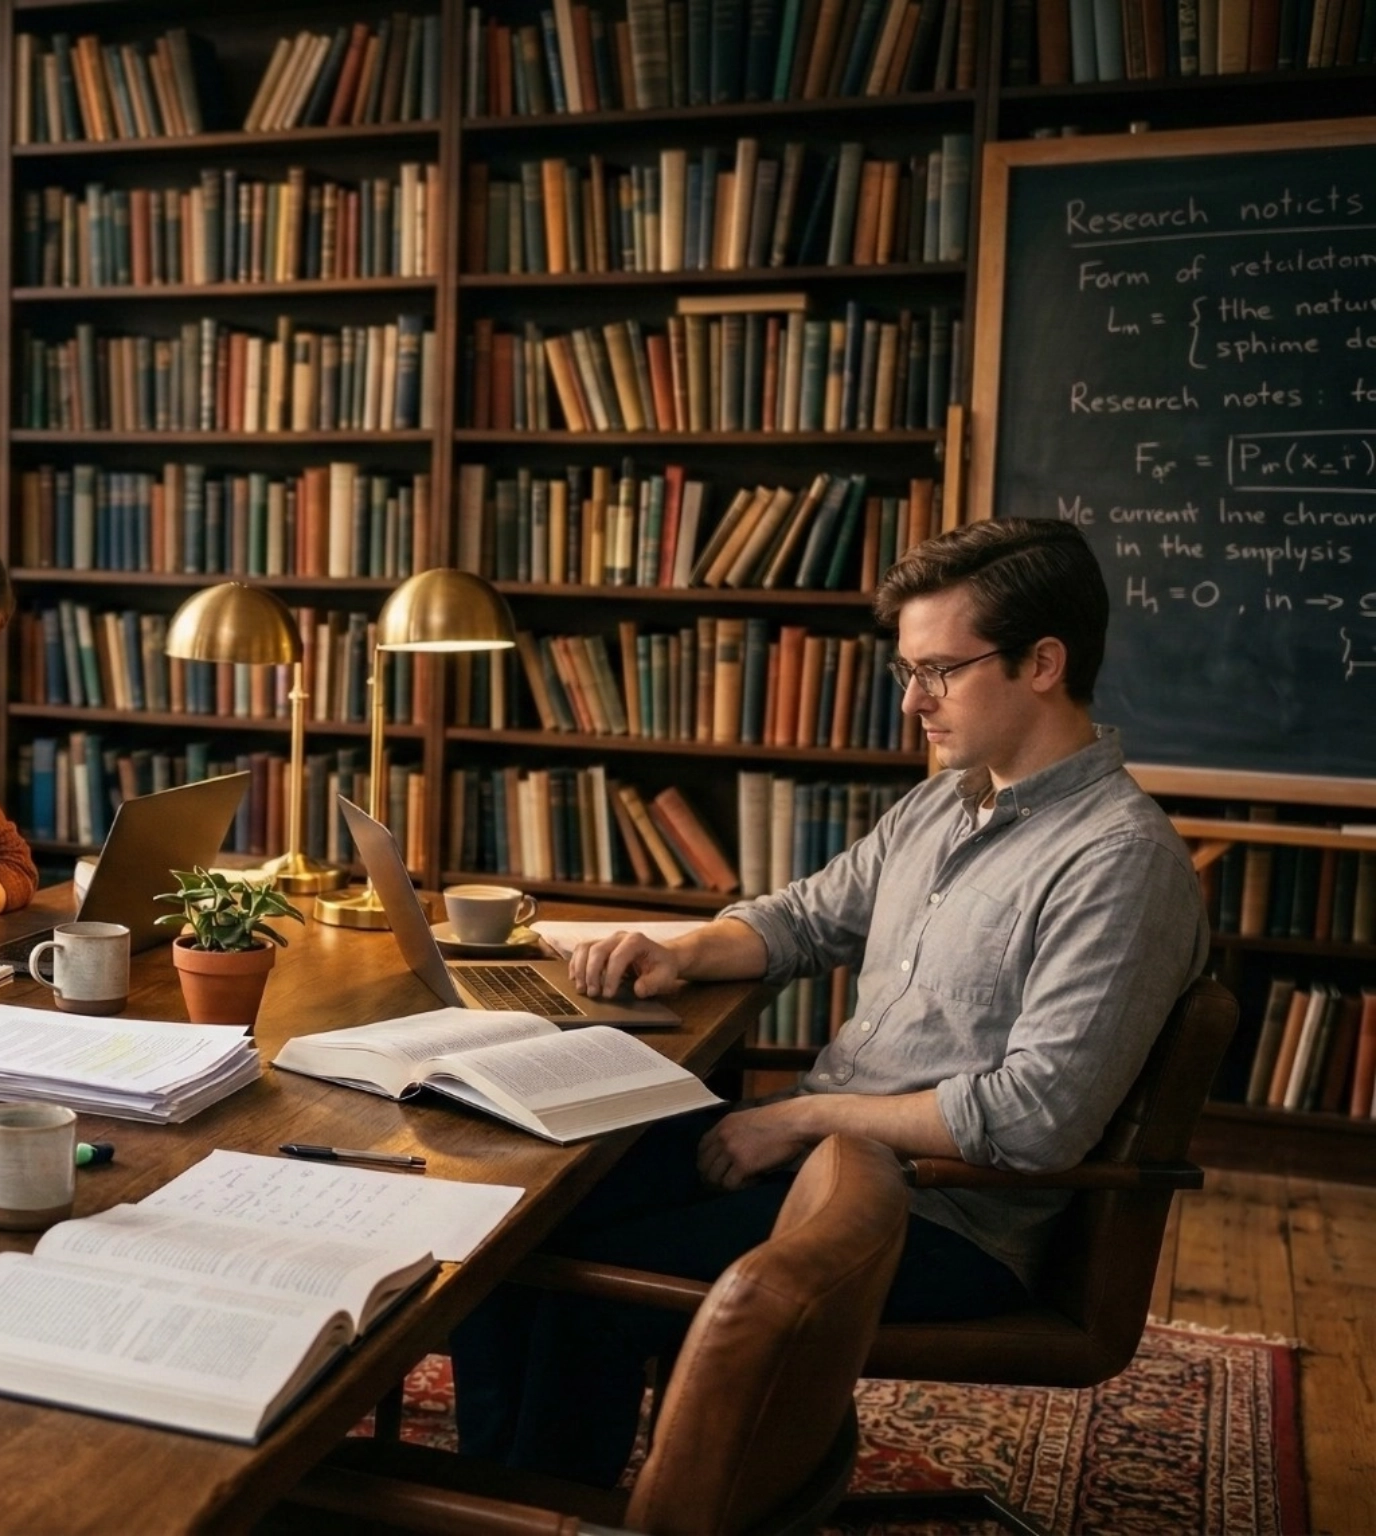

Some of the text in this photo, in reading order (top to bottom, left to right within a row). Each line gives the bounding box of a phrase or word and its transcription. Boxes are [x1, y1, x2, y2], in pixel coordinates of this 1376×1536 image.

[1067, 186, 1363, 237] Research noticts
[1176, 254, 1205, 282] of
[1217, 332, 1318, 362] sphime
[1071, 382, 1198, 413] Research
[1224, 382, 1302, 407] notes
[1116, 535, 1140, 557] in
[1159, 534, 1203, 558] the
[1265, 588, 1292, 610] in
